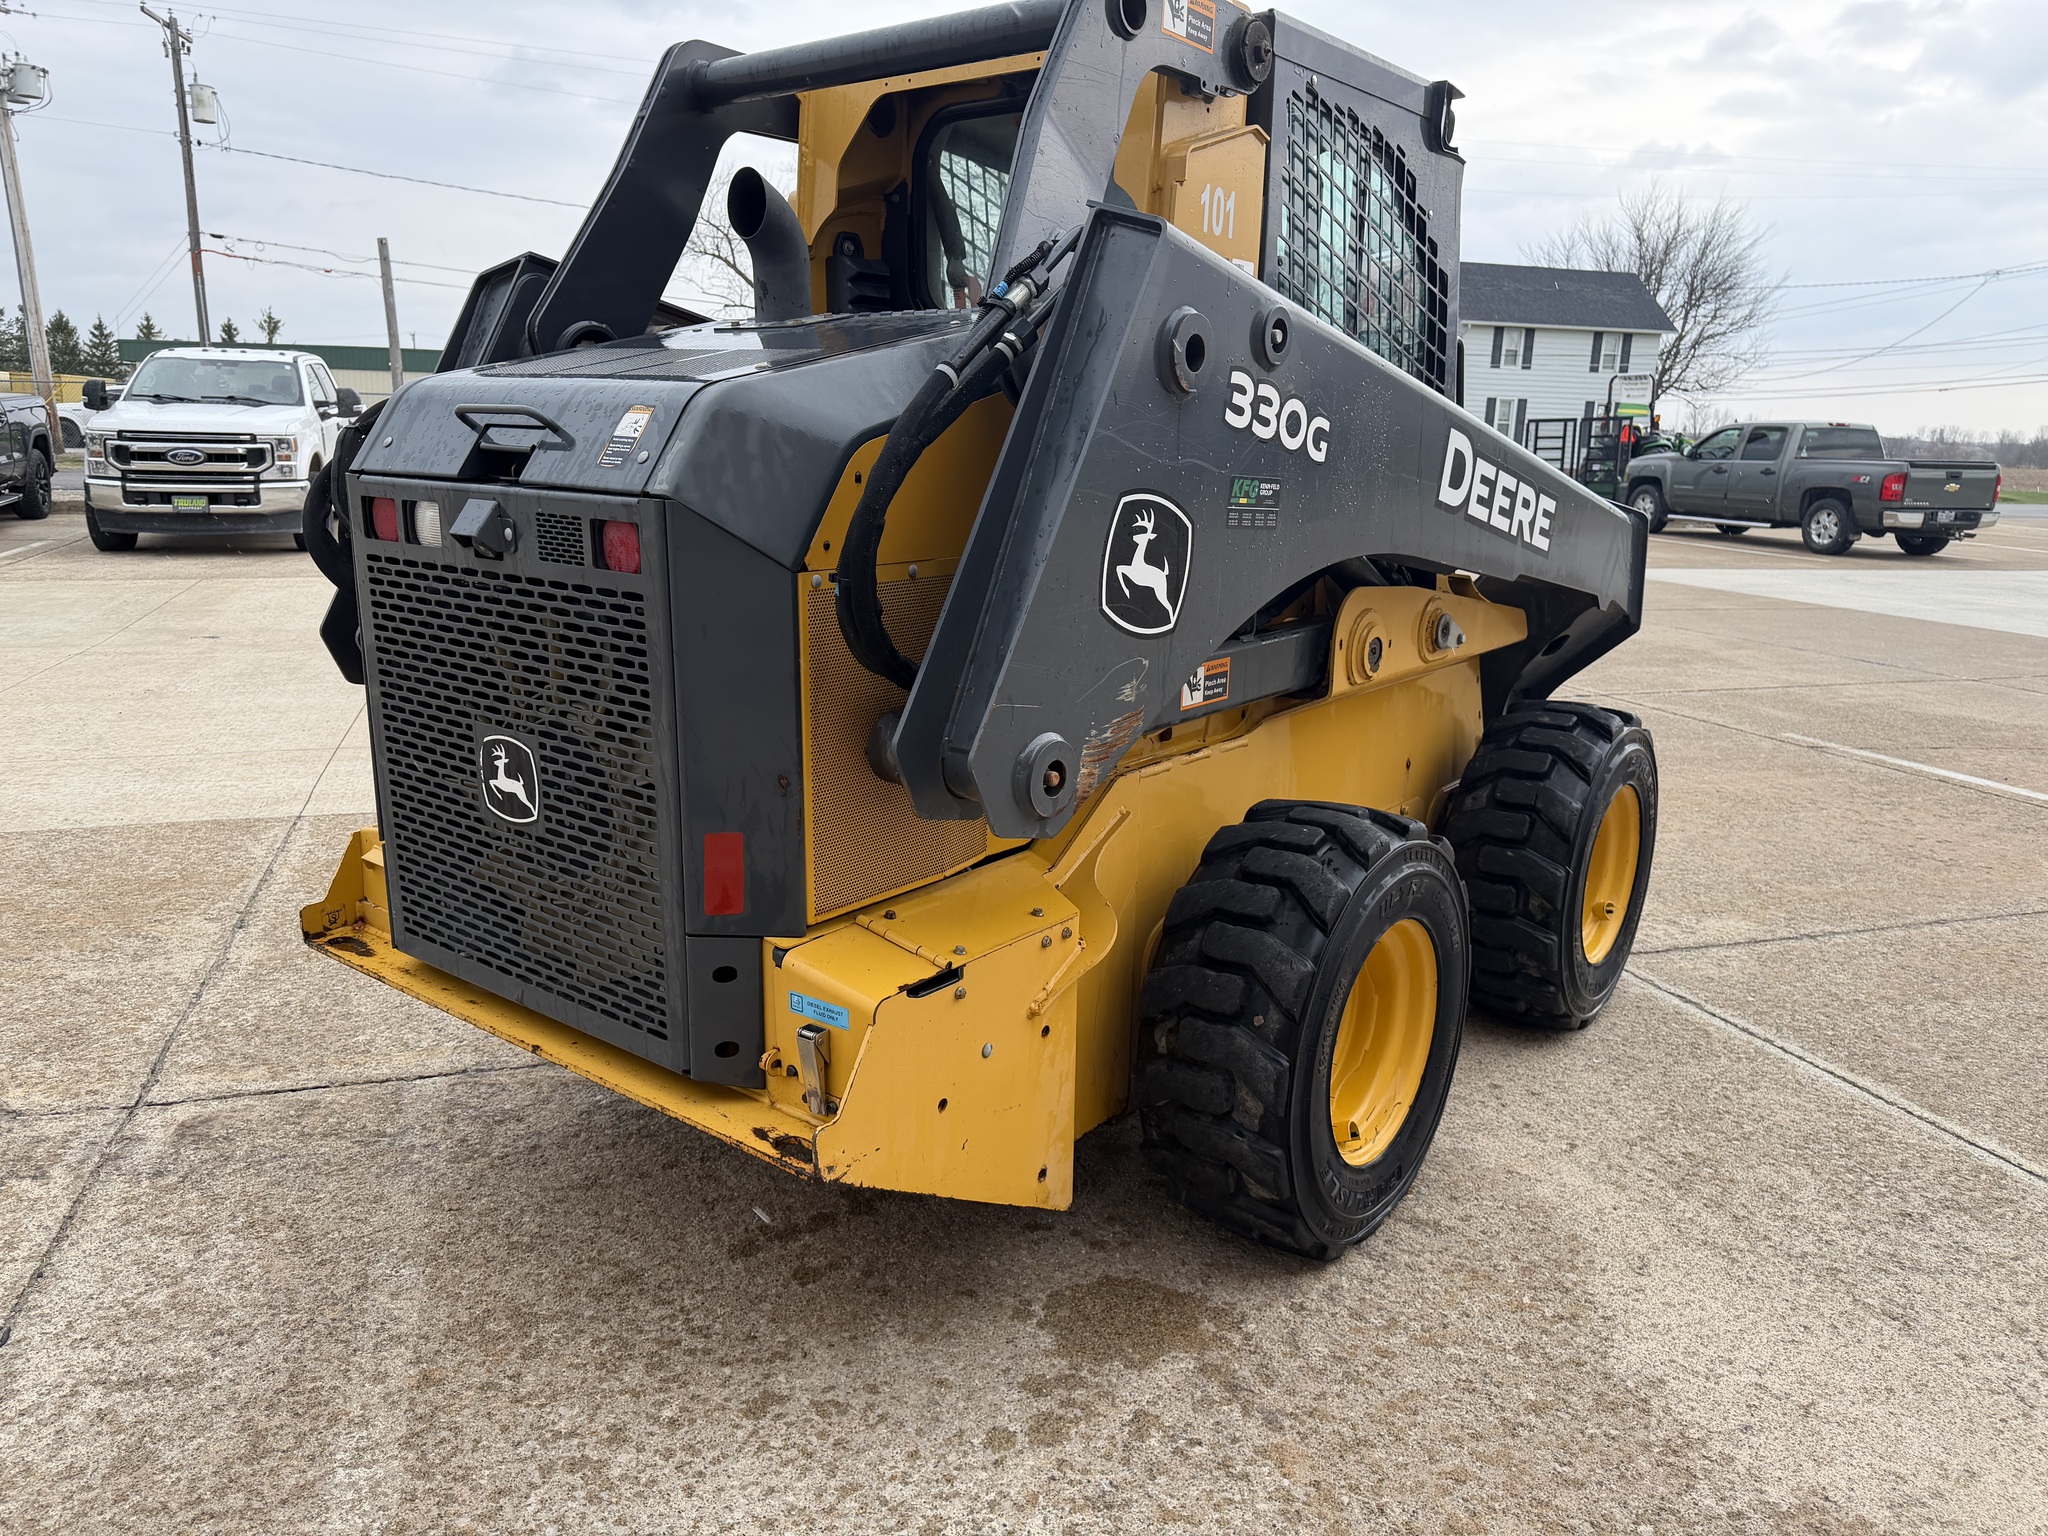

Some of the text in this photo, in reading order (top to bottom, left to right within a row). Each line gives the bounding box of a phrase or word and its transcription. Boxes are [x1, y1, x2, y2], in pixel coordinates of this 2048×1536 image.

[1188, 15, 1211, 32] Pinch Area
[1188, 26, 1208, 42] Keep Away
[1201, 183, 1236, 239] 101
[1224, 370, 1331, 464] 330G
[175, 451, 195, 461] Ford
[1231, 479, 1260, 498] KFG
[1438, 427, 1557, 552] DEERE
[1210, 662, 1228, 670] WARNING
[806, 1001, 822, 1010] DIESEL
[822, 1006, 844, 1017] EXHAUST
[813, 1009, 839, 1022] FLUID ONLY
